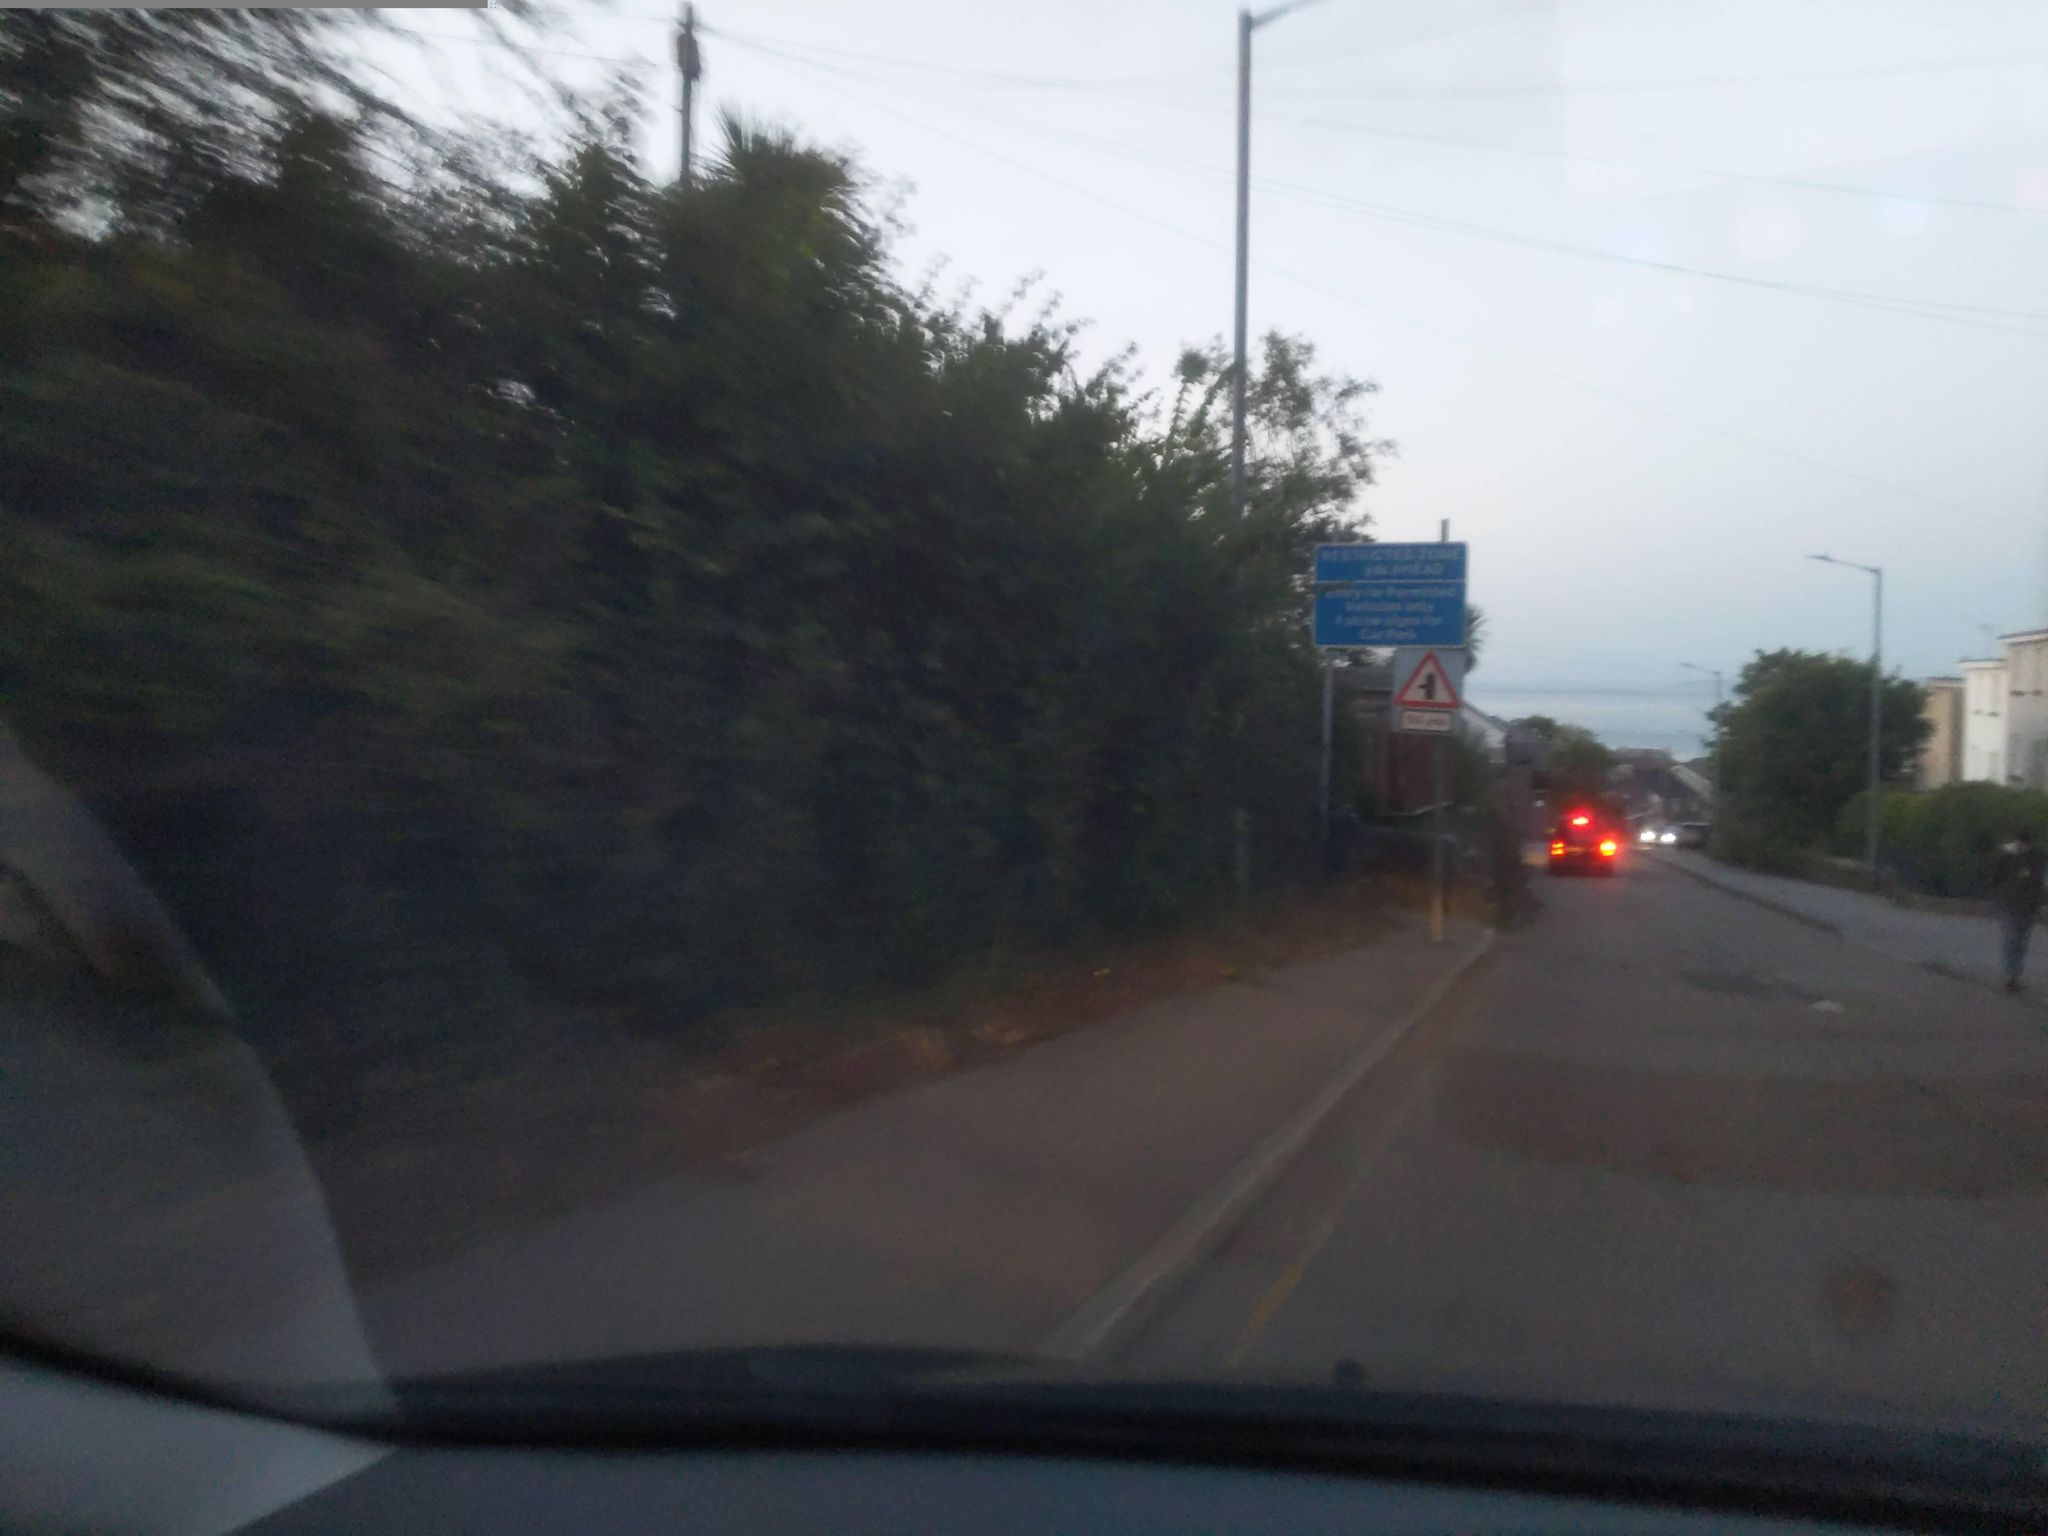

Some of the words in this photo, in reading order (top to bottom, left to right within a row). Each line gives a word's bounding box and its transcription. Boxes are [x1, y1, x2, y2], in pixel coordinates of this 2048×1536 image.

[1322, 549, 1415, 561] RESTRICTED
[1420, 548, 1460, 560] ZONE
[1392, 564, 1444, 575] AHEAD
[1386, 586, 1456, 598] Permitted
[1422, 615, 1443, 625] for
[1360, 629, 1383, 640] Car
[1386, 628, 1417, 640] Park
